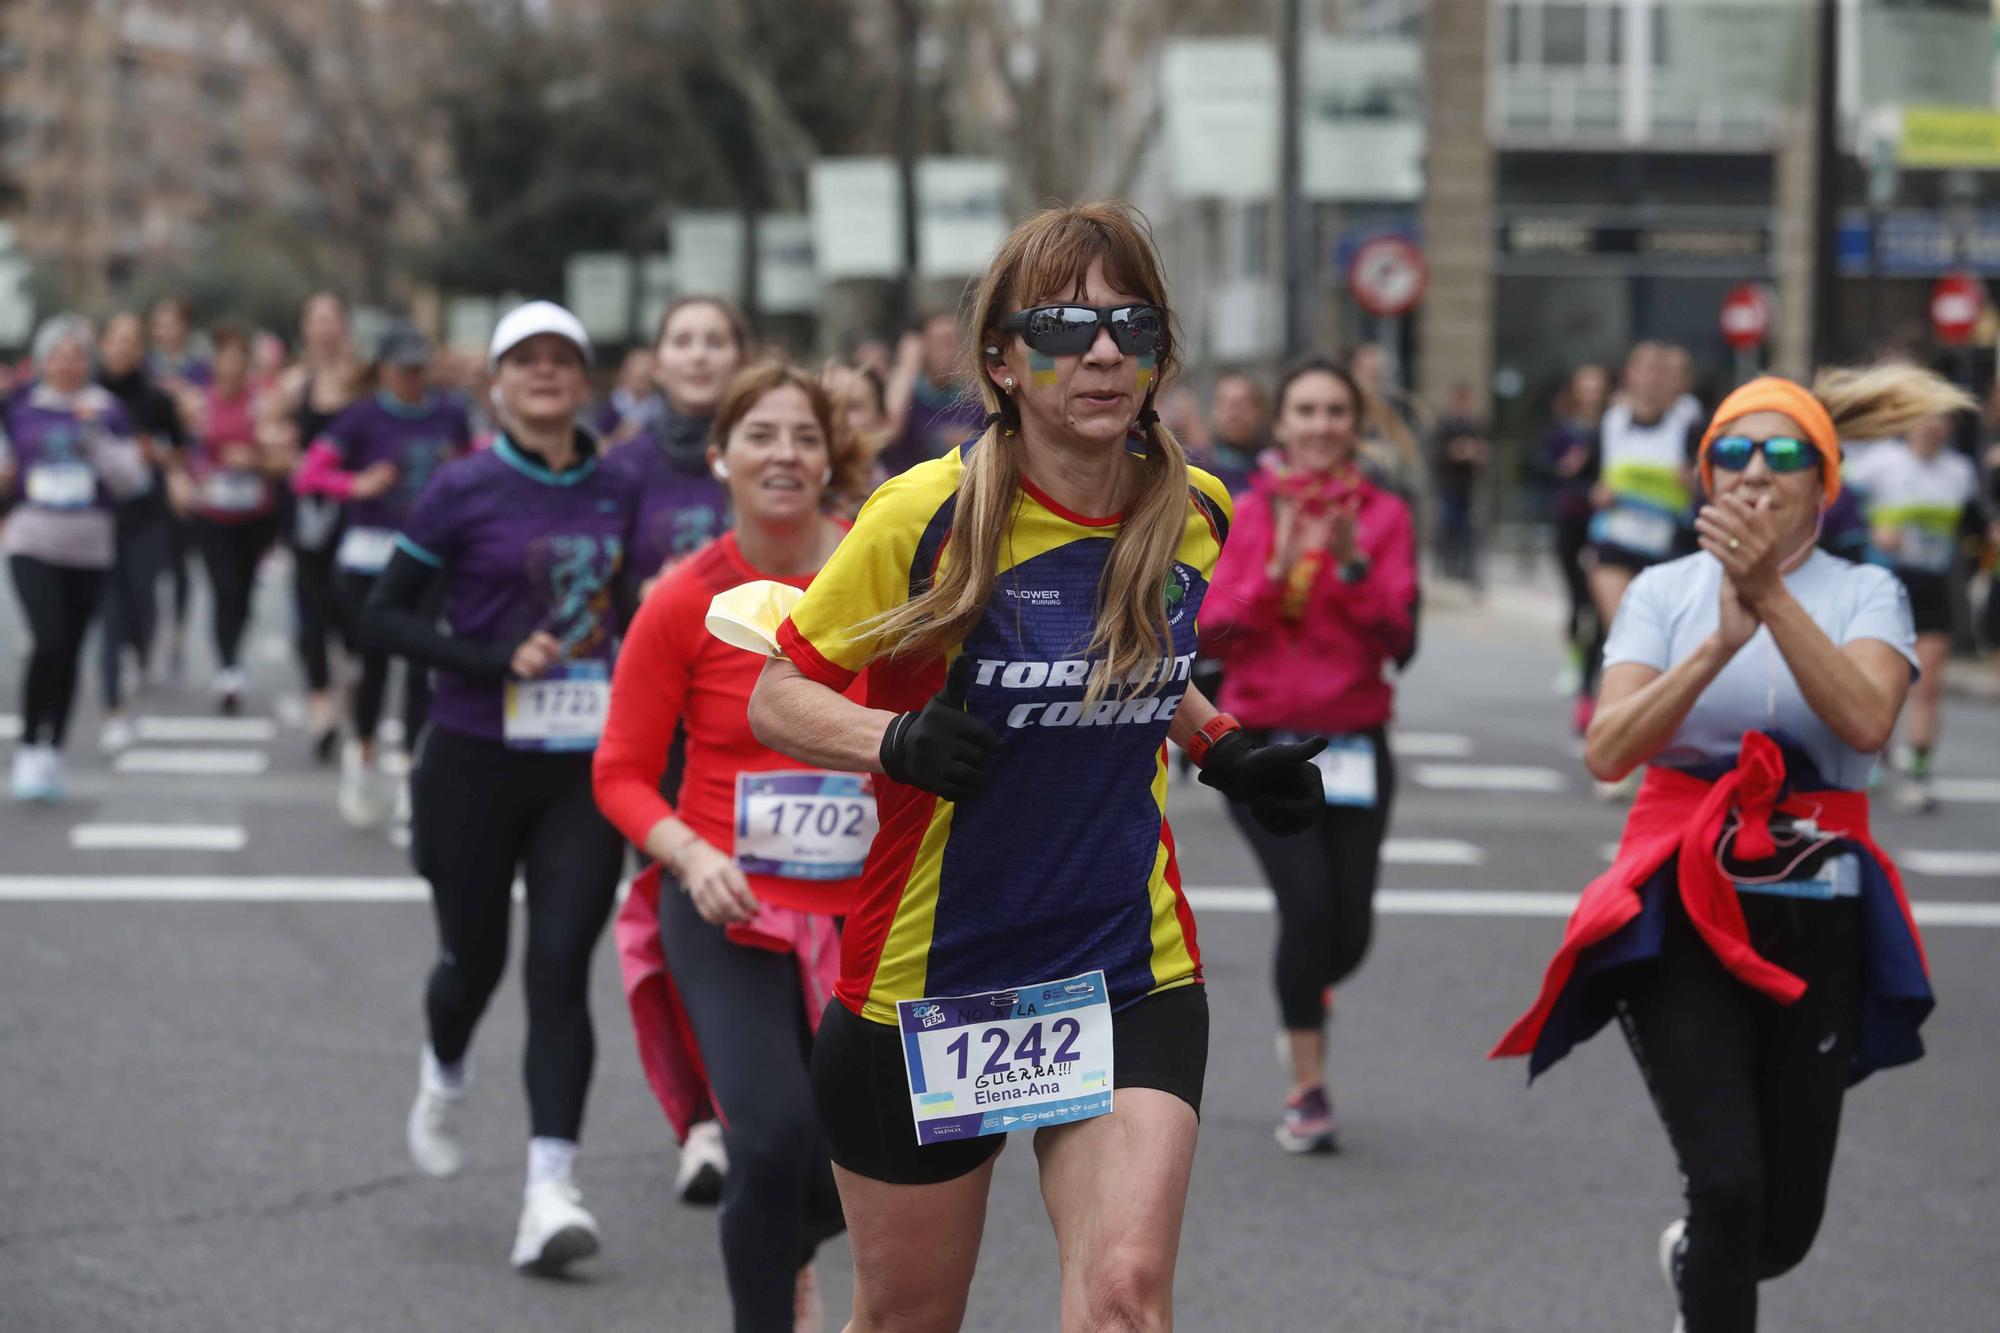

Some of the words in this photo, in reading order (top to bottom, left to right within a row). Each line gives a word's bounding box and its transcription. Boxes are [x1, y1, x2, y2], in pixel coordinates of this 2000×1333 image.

[1006, 589, 1060, 599] FLOWER
[769, 803, 865, 837] 1702
[924, 1014, 945, 1027] FEM
[1017, 1003, 1038, 1016] LA
[946, 1017, 1081, 1080] 1242
[975, 1062, 1072, 1089] GUERRA!!!
[974, 1081, 1060, 1105] Elena-Ana
